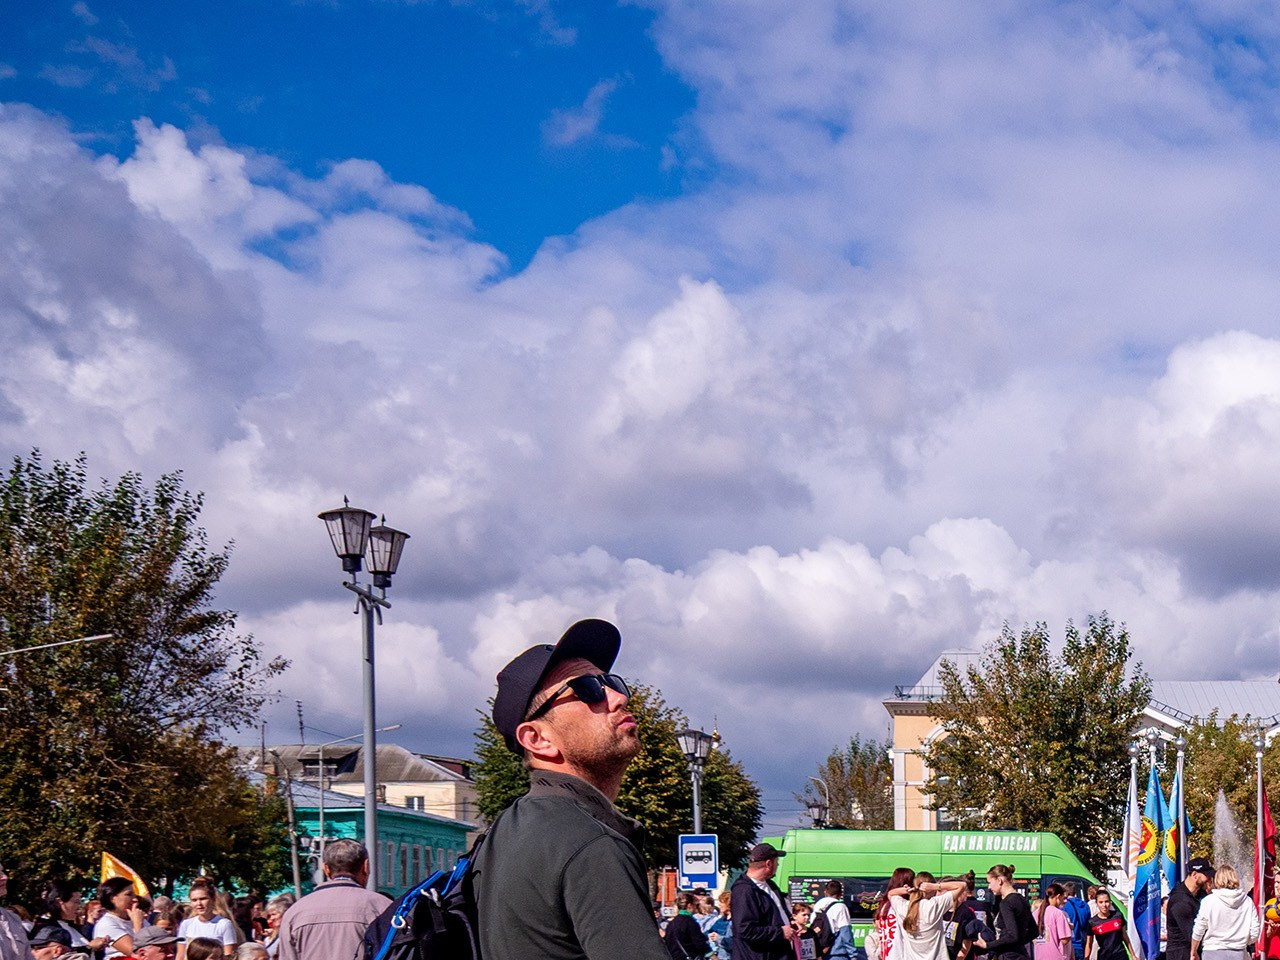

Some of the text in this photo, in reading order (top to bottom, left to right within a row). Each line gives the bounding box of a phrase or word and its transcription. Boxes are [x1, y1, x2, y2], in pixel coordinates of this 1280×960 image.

[944, 835, 1039, 852] ЕДА НА КОЛЕСАХ
